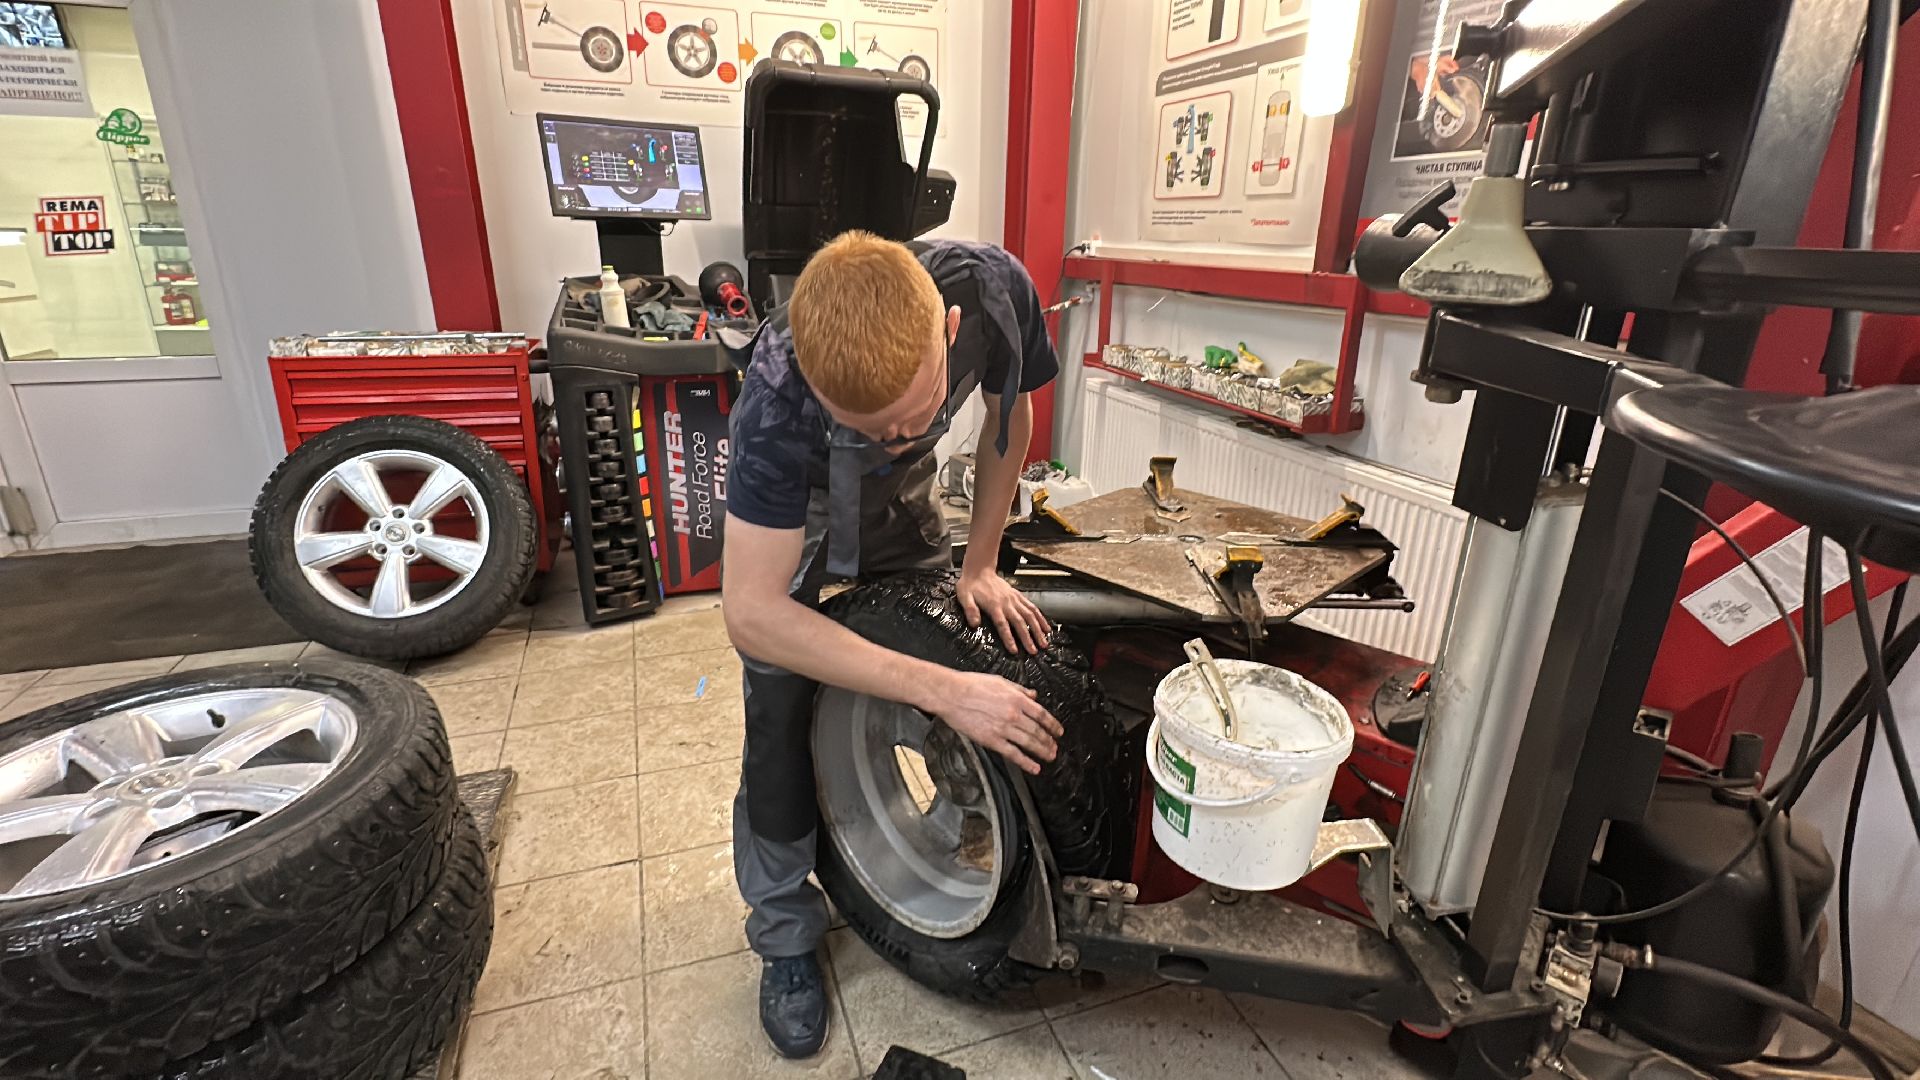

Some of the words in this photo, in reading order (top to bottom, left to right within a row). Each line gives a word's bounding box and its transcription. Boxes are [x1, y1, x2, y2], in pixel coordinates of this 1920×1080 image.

[1416, 163, 1444, 174] ЧИСТАЯ
[1446, 160, 1483, 172] СТУПИЦА
[46, 200, 99, 212] REMA
[38, 213, 97, 230] TIP
[54, 231, 111, 250] TOP
[692, 431, 709, 488] Force
[664, 410, 691, 534] HUNTER
[694, 489, 712, 539] Road
